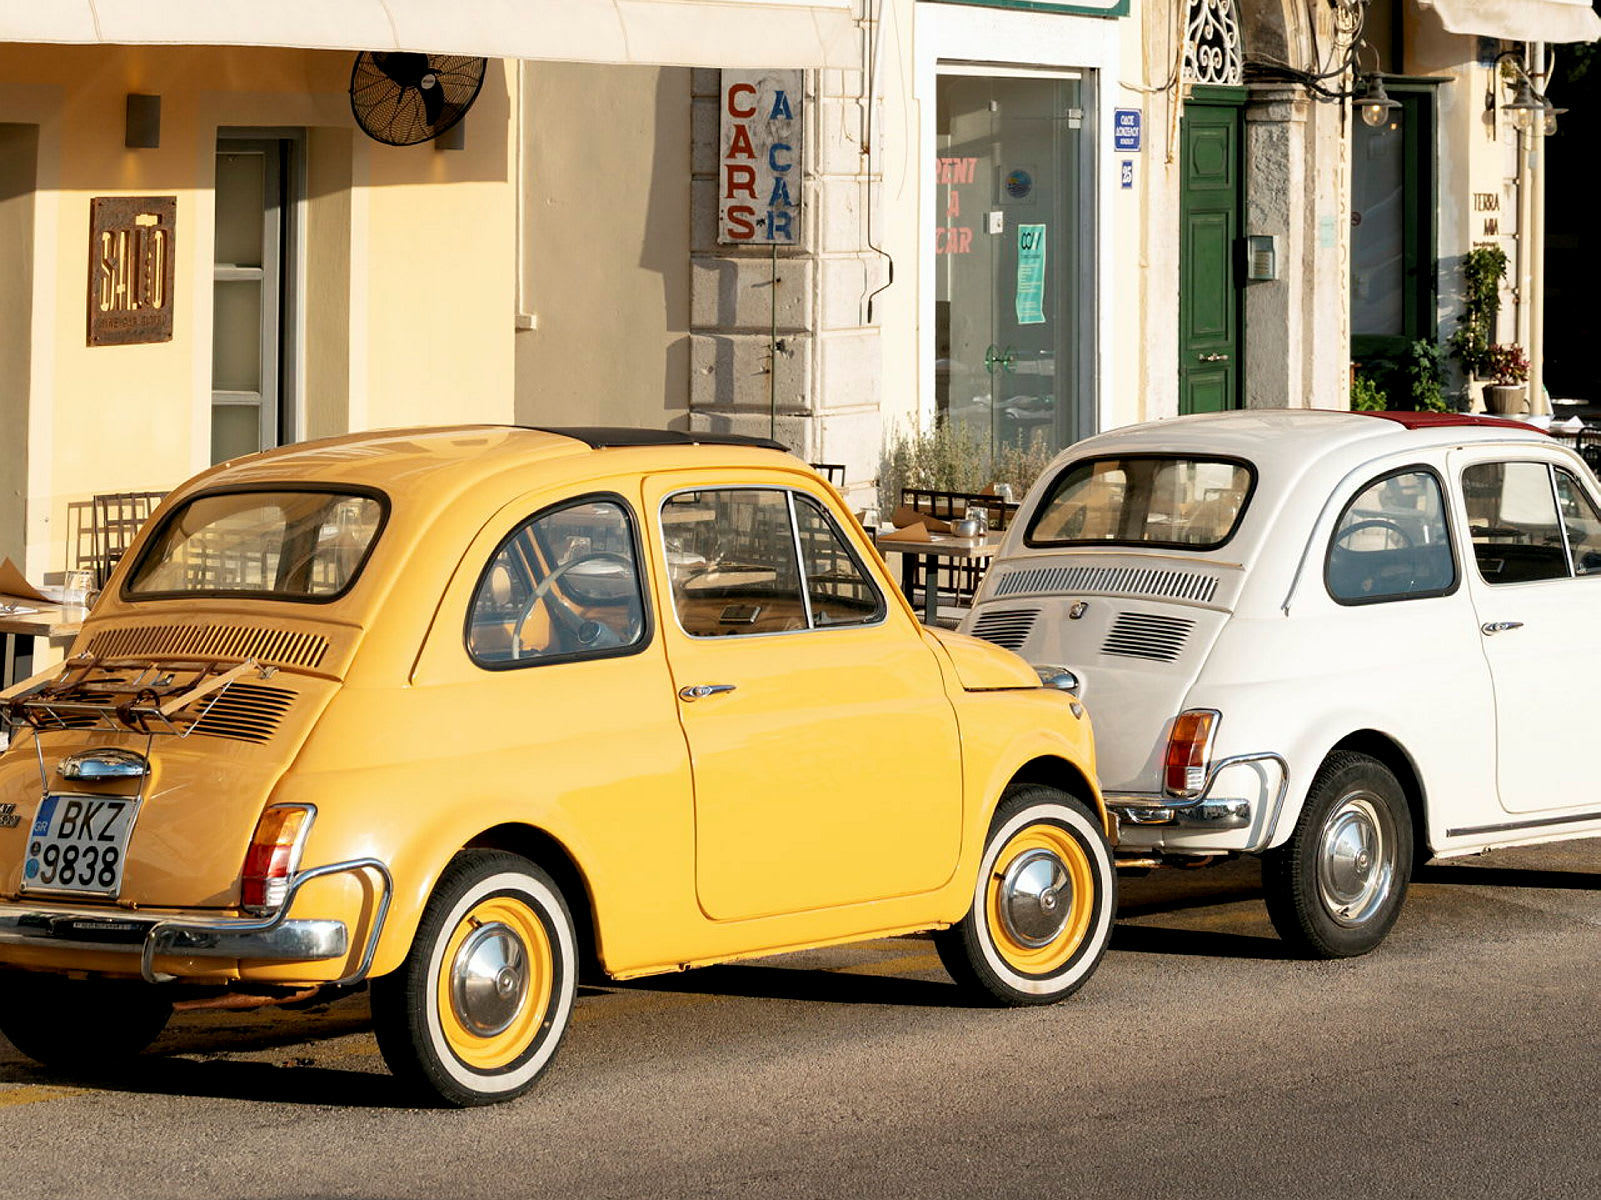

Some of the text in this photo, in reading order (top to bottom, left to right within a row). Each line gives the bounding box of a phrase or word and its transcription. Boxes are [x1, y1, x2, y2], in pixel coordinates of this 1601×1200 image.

[724, 83, 759, 240] CARS
[766, 90, 794, 240] A CAR
[946, 190, 959, 218] A
[1473, 192, 1500, 211] TERRA
[1483, 217, 1499, 236] MIA
[936, 227, 973, 255] CAR
[34, 821, 48, 832] GR
[57, 801, 126, 842] BKZ
[40, 843, 119, 888] 9838
